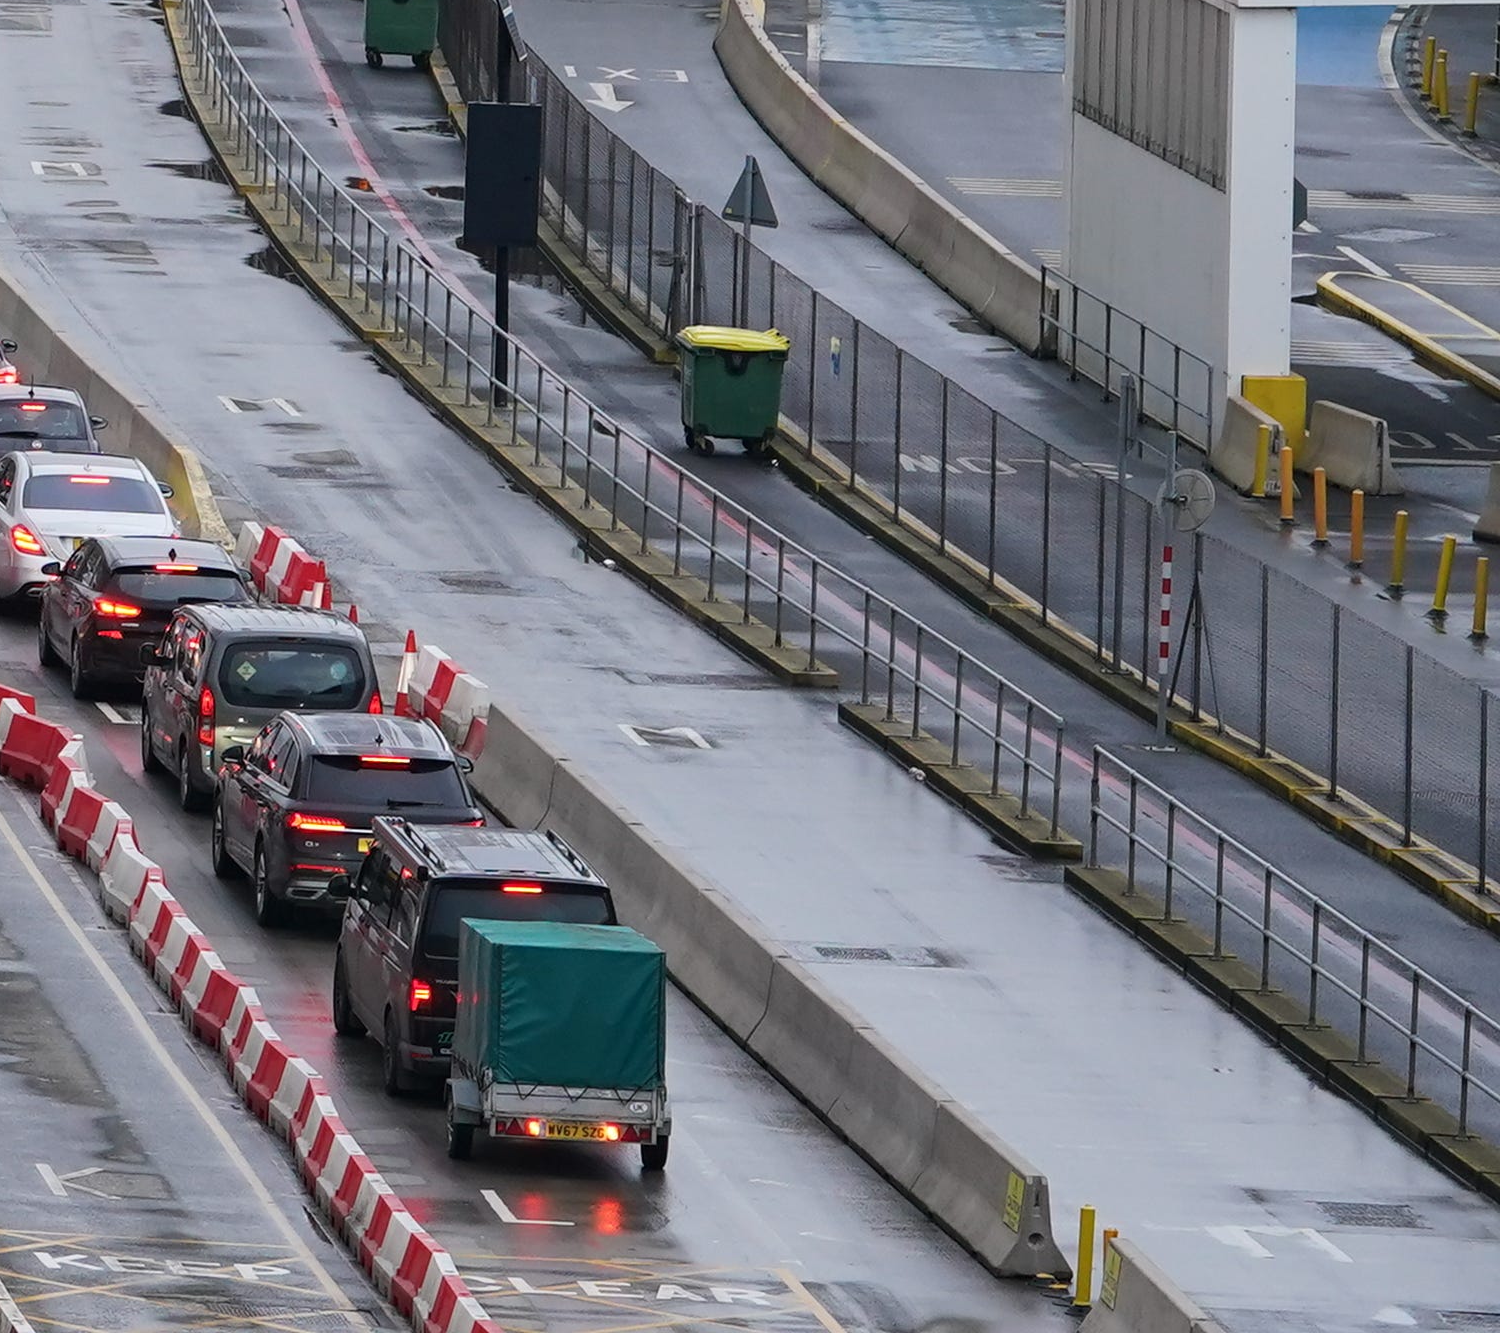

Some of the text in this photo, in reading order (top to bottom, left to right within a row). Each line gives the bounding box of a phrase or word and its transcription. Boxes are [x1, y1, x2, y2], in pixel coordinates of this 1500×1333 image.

[547, 1121, 579, 1136] WV67
[35, 1162, 122, 1200] K
[479, 1188, 576, 1226] L
[30, 1250, 293, 1281] KEEP
